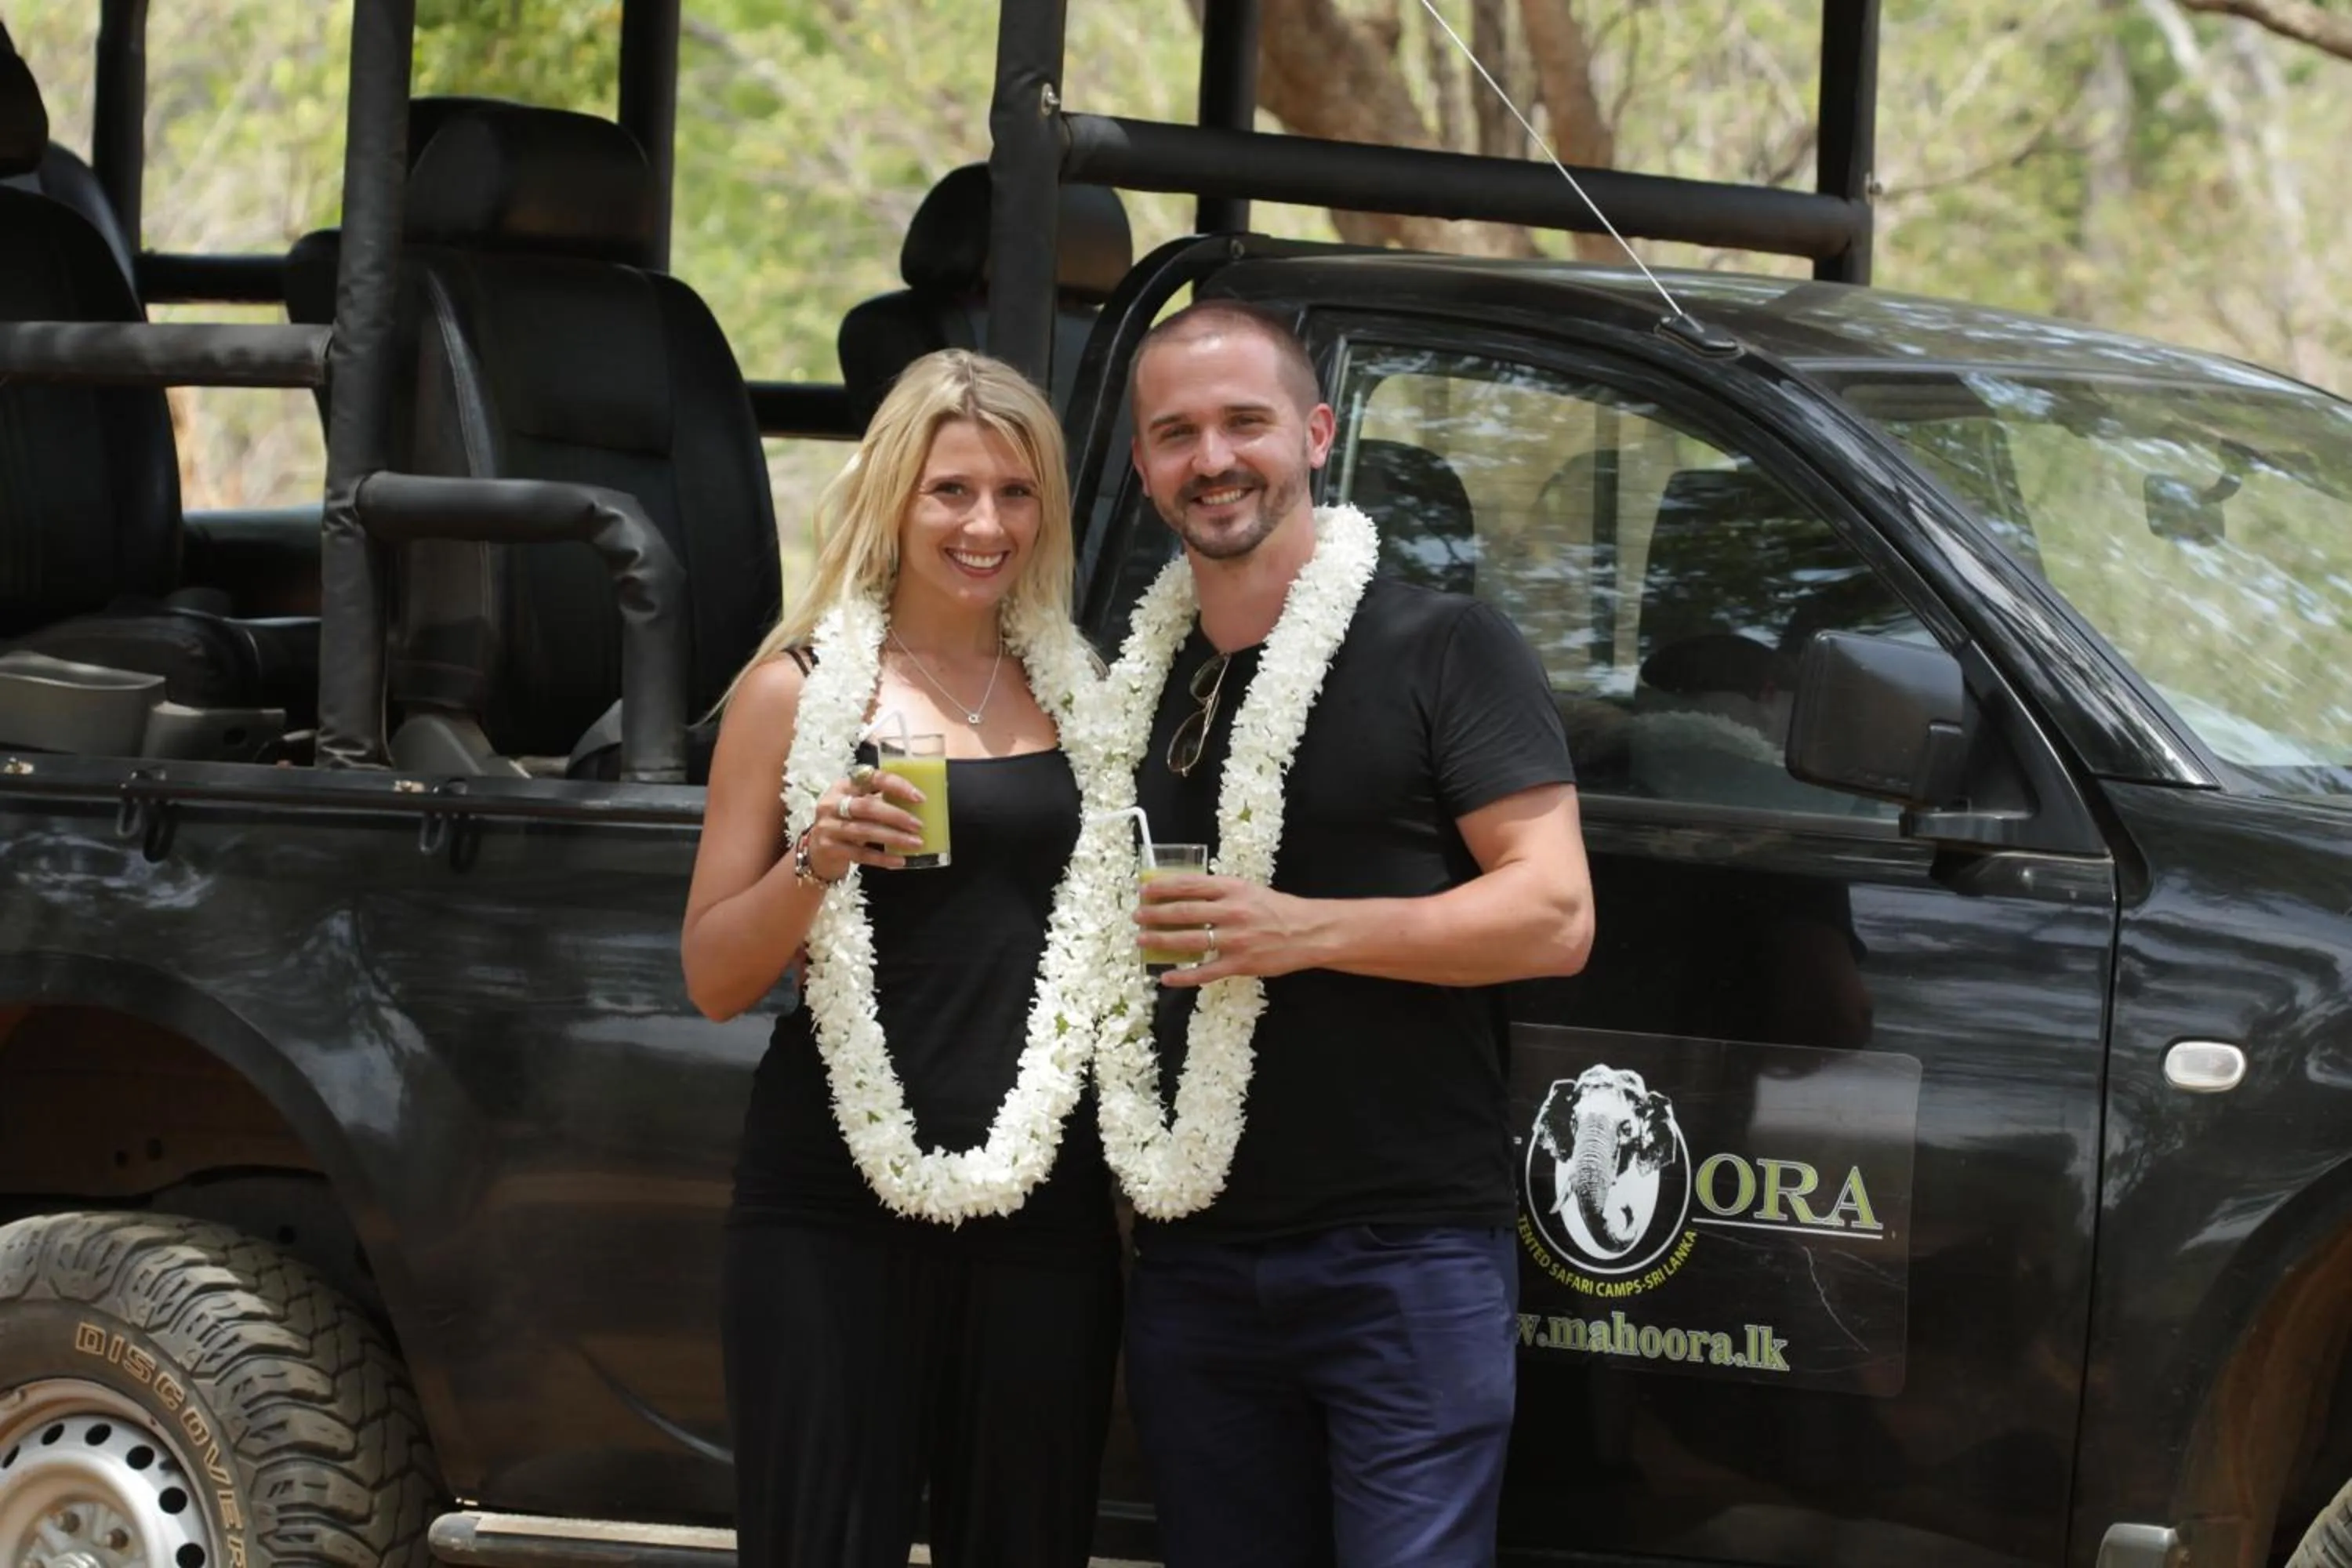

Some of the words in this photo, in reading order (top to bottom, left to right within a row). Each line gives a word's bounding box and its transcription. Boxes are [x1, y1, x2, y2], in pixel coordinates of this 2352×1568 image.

[1695, 1152, 1884, 1230] ORA
[1517, 1214, 1552, 1268] TENTED
[1548, 1262, 1594, 1295] SAFARI
[1663, 1230, 1697, 1276] LANKA
